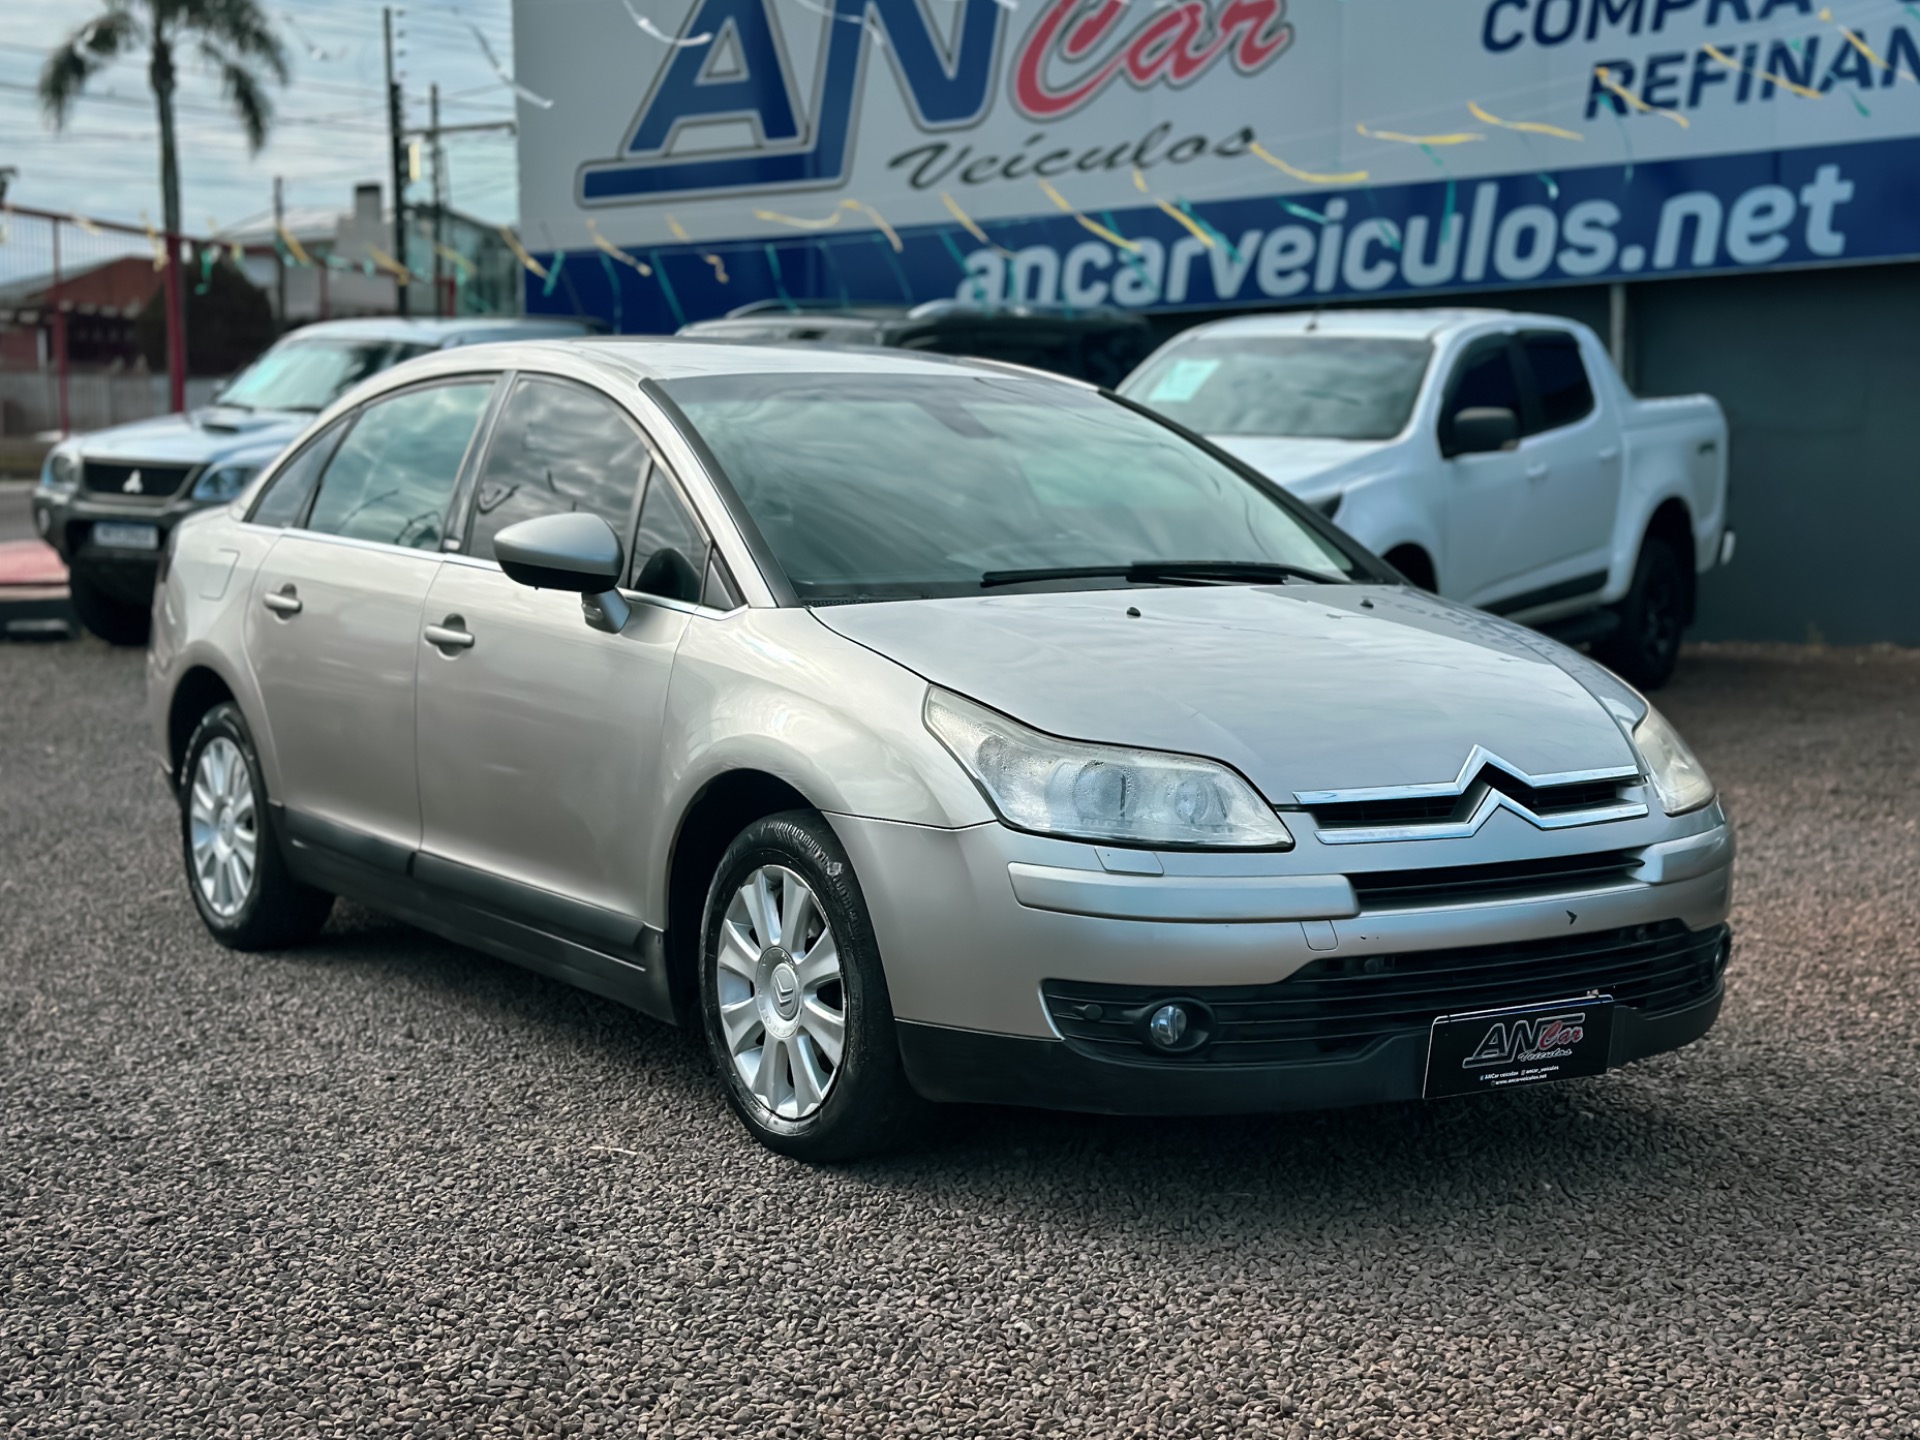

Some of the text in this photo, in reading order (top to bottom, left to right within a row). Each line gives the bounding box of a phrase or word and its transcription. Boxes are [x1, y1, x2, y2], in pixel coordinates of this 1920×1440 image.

[1584, 24, 1920, 120] REFINAN
[886, 120, 1256, 190] Veículos
[955, 163, 1855, 308] ancarveiculos.net
